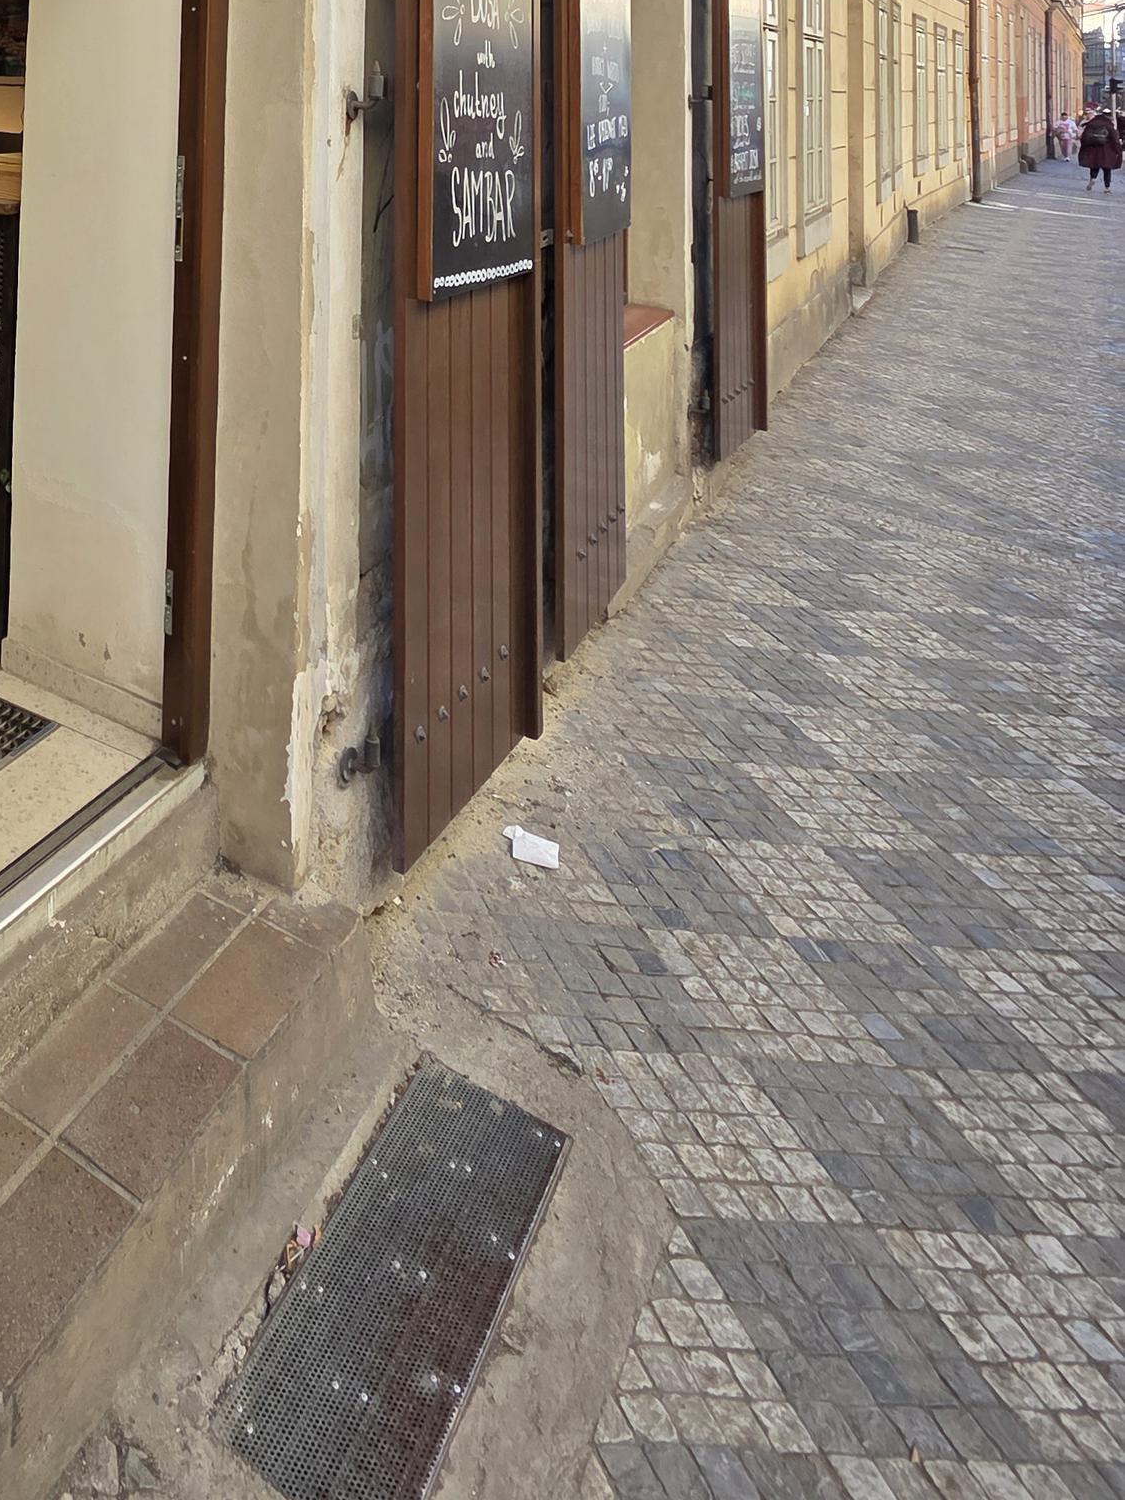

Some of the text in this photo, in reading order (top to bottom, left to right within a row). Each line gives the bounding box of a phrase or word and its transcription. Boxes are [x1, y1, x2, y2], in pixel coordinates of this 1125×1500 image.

[476, 40, 496, 69] with
[453, 69, 507, 140] chutney
[475, 132, 495, 160] and
[451, 166, 516, 248] SAMBAR
